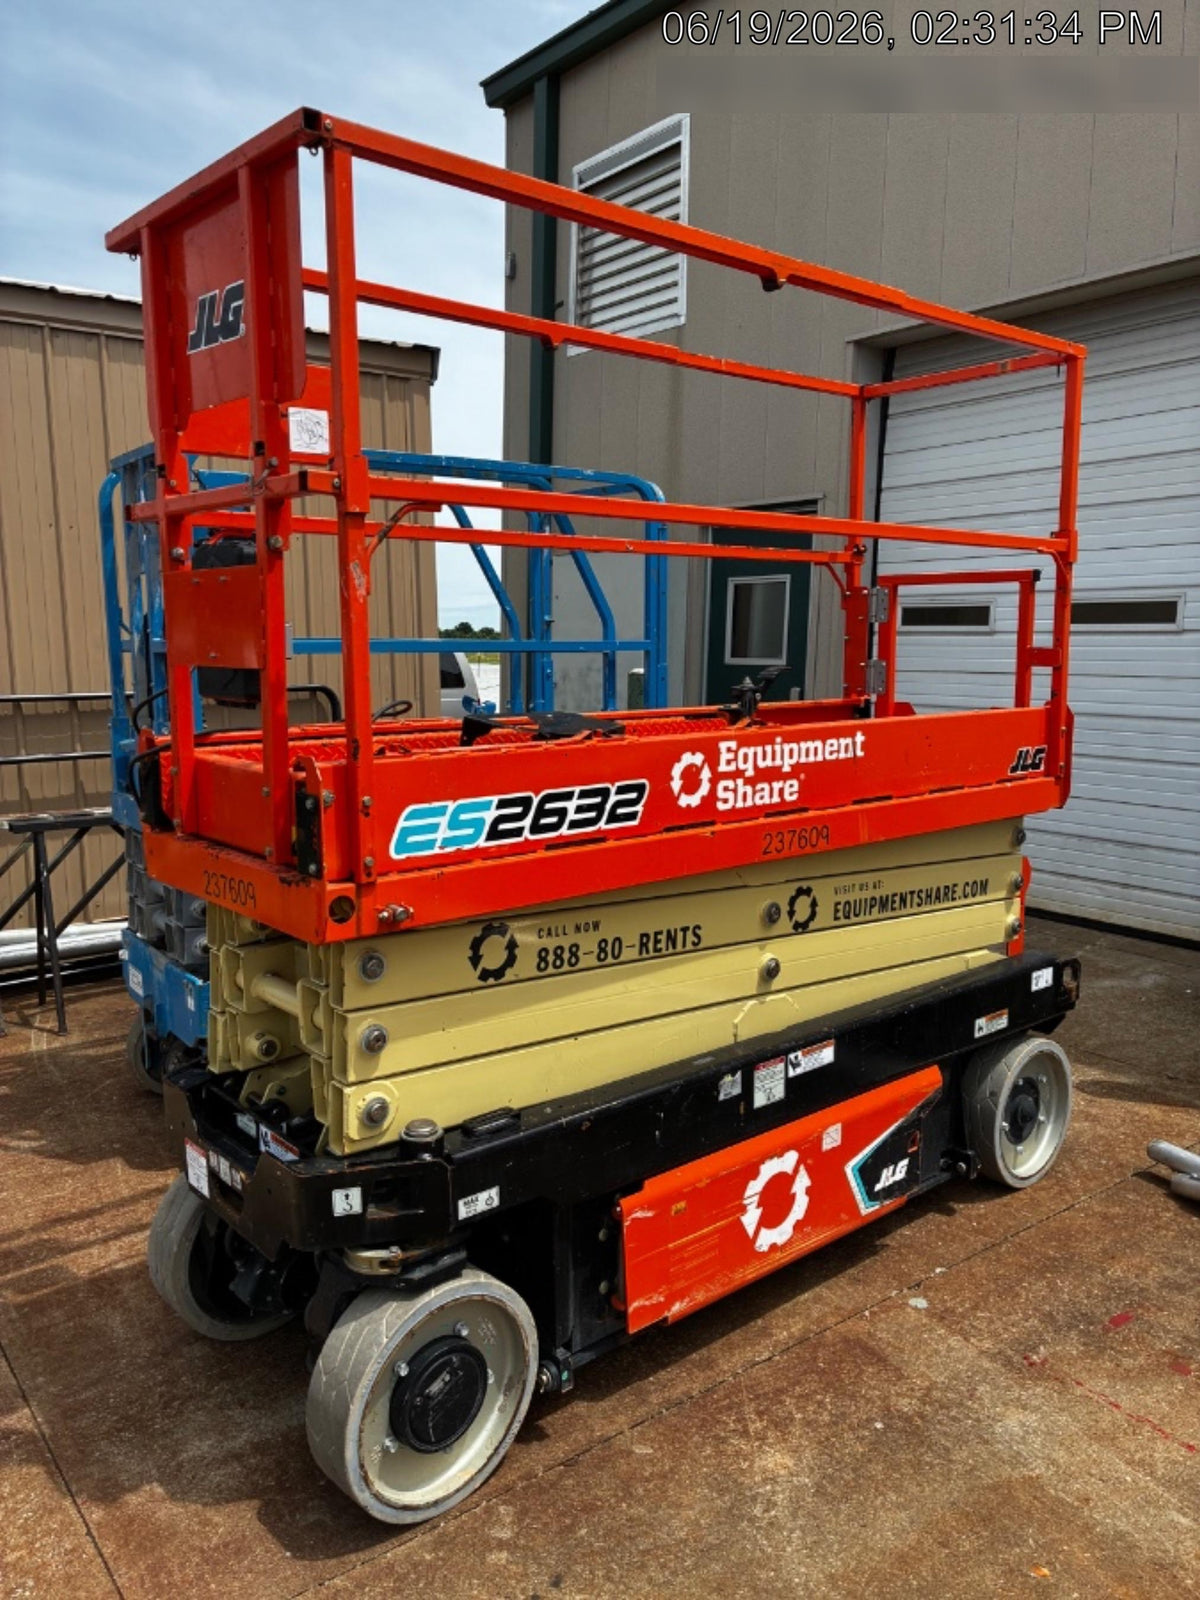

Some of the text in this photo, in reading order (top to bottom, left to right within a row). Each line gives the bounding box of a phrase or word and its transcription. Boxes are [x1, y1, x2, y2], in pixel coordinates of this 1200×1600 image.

[187, 280, 245, 354] JLG
[717, 731, 865, 776] Equipment
[1009, 746, 1047, 775] JLG
[716, 778, 799, 811] Share
[389, 779, 649, 860] ES2632
[761, 824, 831, 856] 237609
[203, 869, 257, 911] 237609
[833, 879, 989, 921] EQUIPMENTSHARE.COM
[535, 924, 703, 973] 888-80-RENTS
[537, 919, 602, 939] CALL NOW
[874, 1158, 910, 1192] JLG
